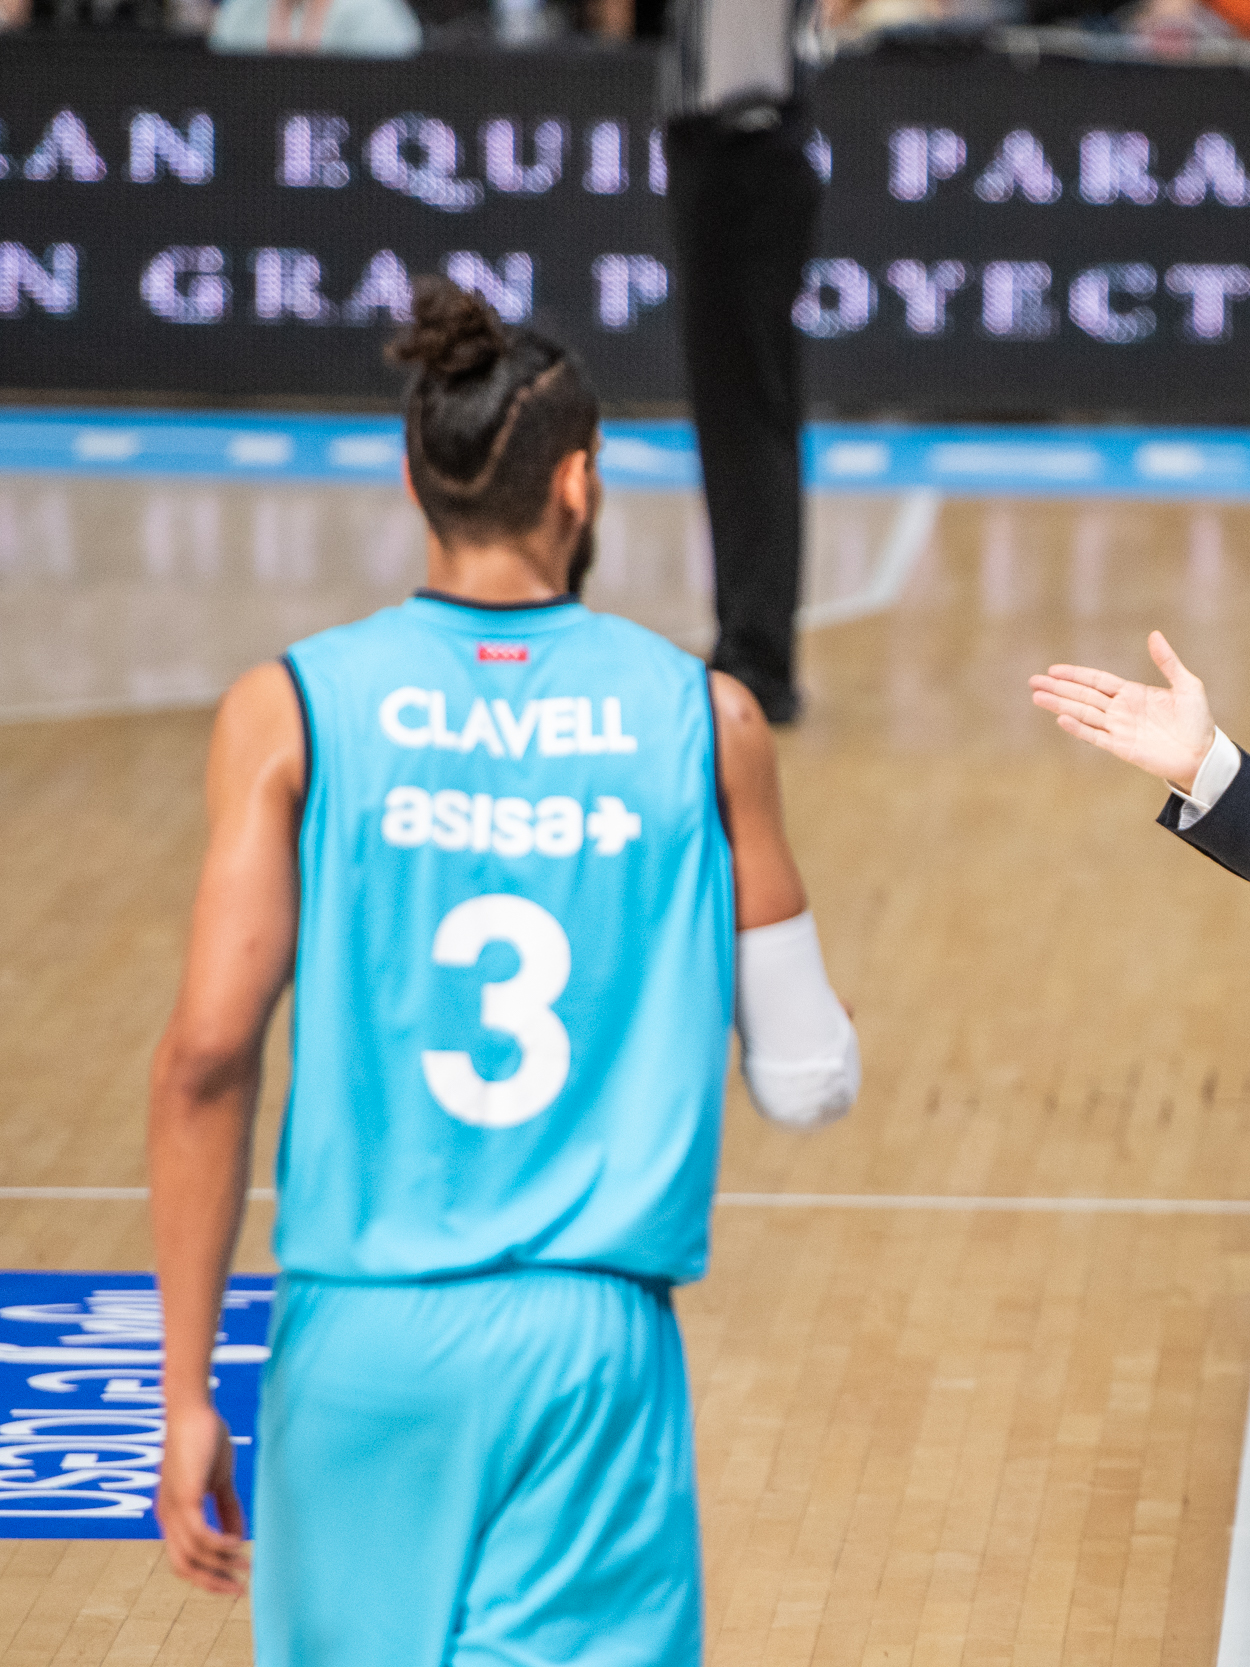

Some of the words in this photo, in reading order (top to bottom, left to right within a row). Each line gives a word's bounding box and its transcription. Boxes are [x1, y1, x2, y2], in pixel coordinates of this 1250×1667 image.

[0, 110, 215, 184] AN
[278, 113, 833, 211] EQUI
[140, 244, 534, 325] GRAN
[379, 687, 637, 760] CLAVELL
[381, 786, 584, 857] asisa
[422, 893, 572, 1128] 3
